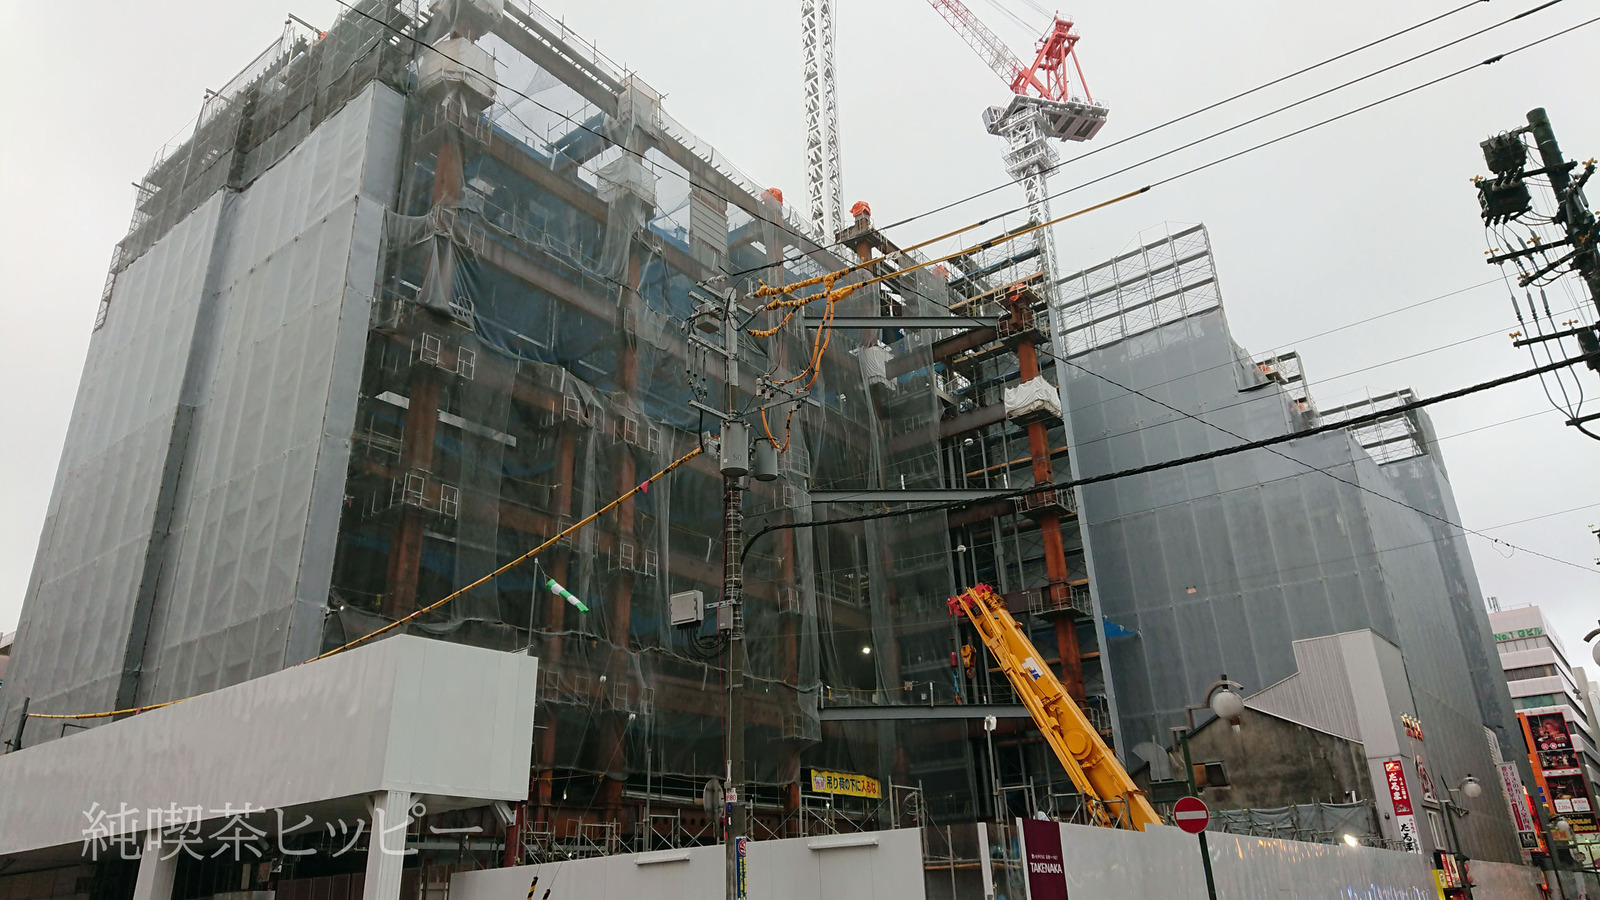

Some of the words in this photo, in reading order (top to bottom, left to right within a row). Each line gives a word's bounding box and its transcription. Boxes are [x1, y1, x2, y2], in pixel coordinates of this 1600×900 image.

[1493, 631, 1514, 642] No.1
[1388, 772, 1402, 801] だるま
[1400, 823, 1415, 853] だるま
[1030, 862, 1063, 874] TAKENAKA
